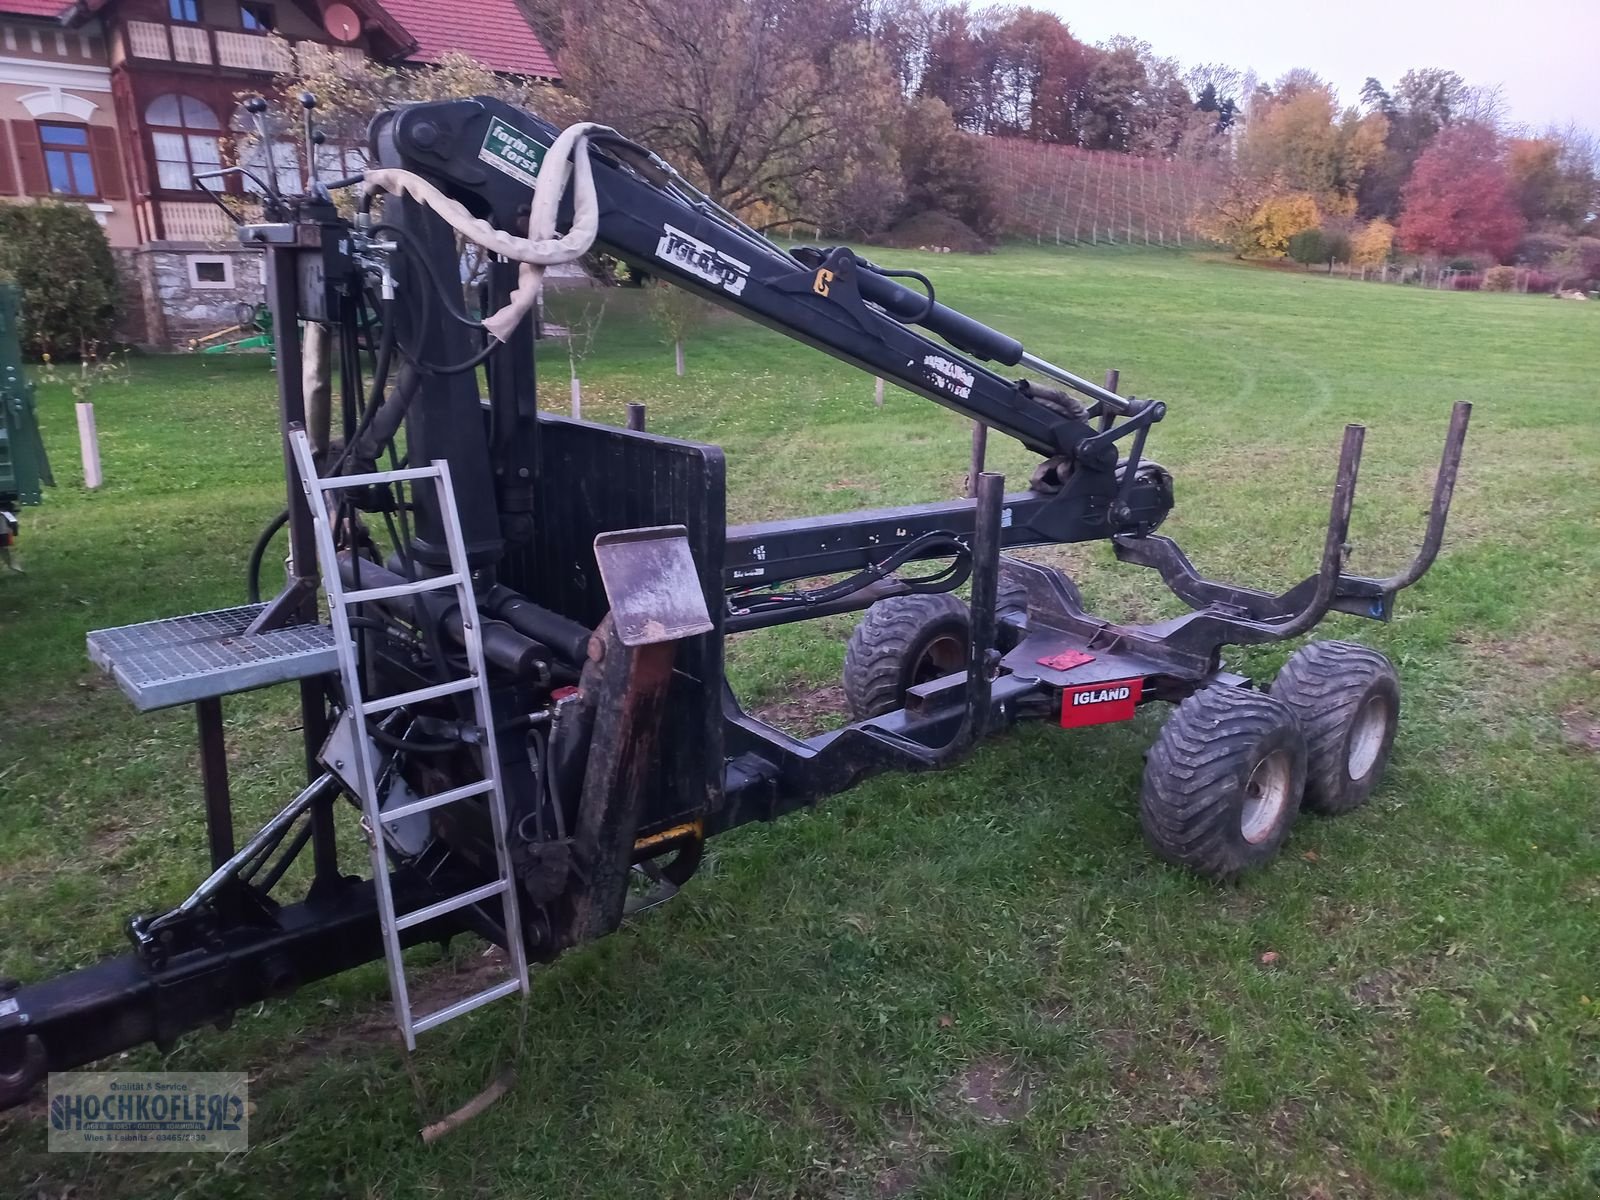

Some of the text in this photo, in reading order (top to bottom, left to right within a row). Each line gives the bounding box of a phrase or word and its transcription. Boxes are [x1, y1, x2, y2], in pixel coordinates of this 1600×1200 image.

[492, 125, 528, 154] farm
[501, 144, 539, 174] forst
[1072, 686, 1131, 706] IGLAND
